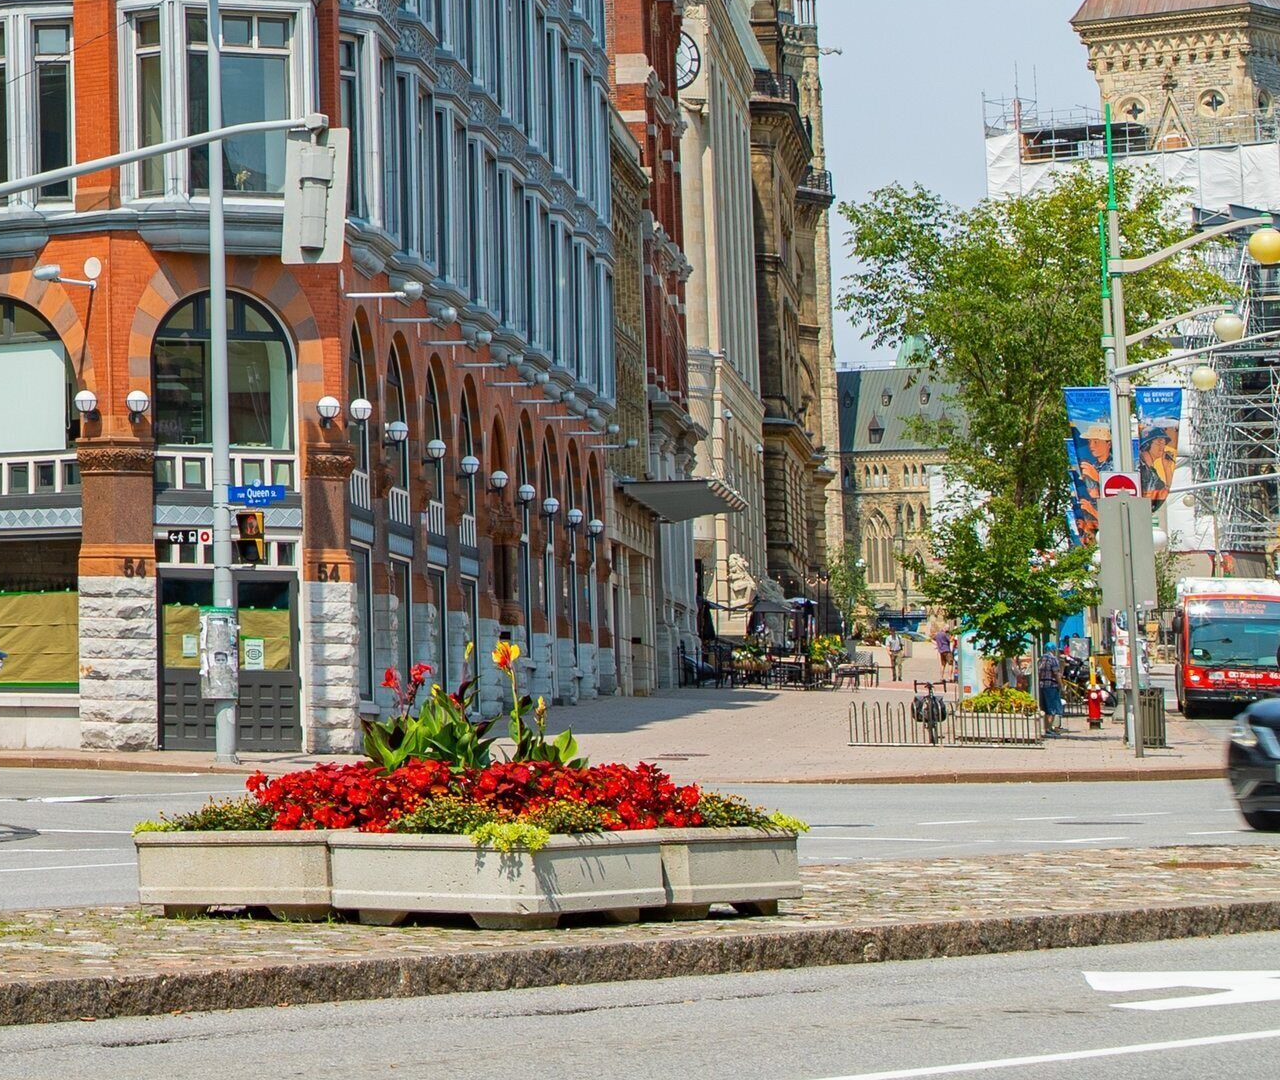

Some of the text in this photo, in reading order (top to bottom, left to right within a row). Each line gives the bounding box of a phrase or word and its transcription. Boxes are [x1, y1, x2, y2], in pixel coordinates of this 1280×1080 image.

[246, 487, 270, 500] Queen
[123, 557, 147, 579] 54
[317, 563, 341, 583] 54
[1239, 671, 1264, 679] Transpo
